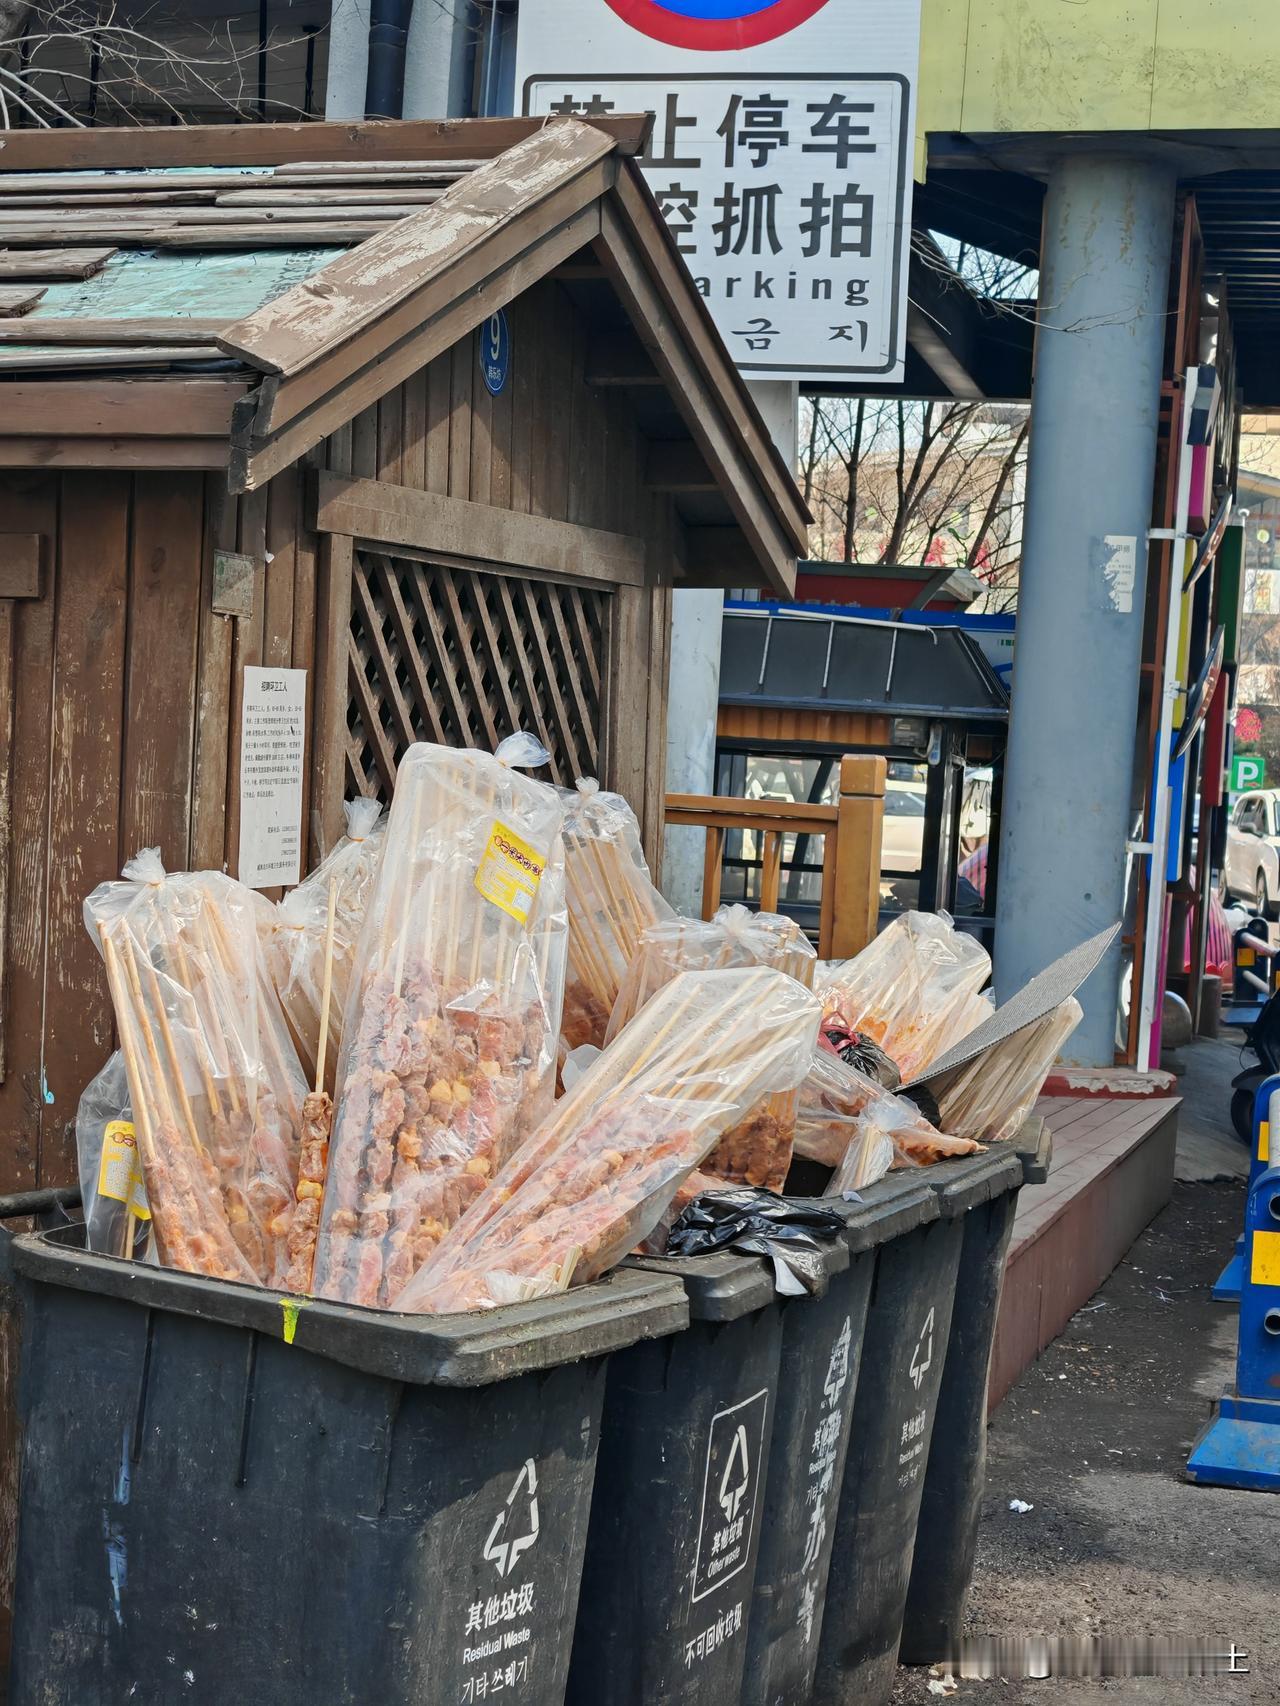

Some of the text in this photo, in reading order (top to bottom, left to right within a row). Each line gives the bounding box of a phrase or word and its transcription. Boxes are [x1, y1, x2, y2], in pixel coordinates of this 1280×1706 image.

[550, 93, 876, 169] 止停车
[491, 311, 500, 361] 9
[1237, 761, 1259, 789] P
[711, 1515, 744, 1556] 其他垃圾
[465, 1582, 535, 1636] 其他垃圾
[463, 1627, 531, 1665] Residual Waste
[685, 1601, 743, 1670] 不可回收垃圾
